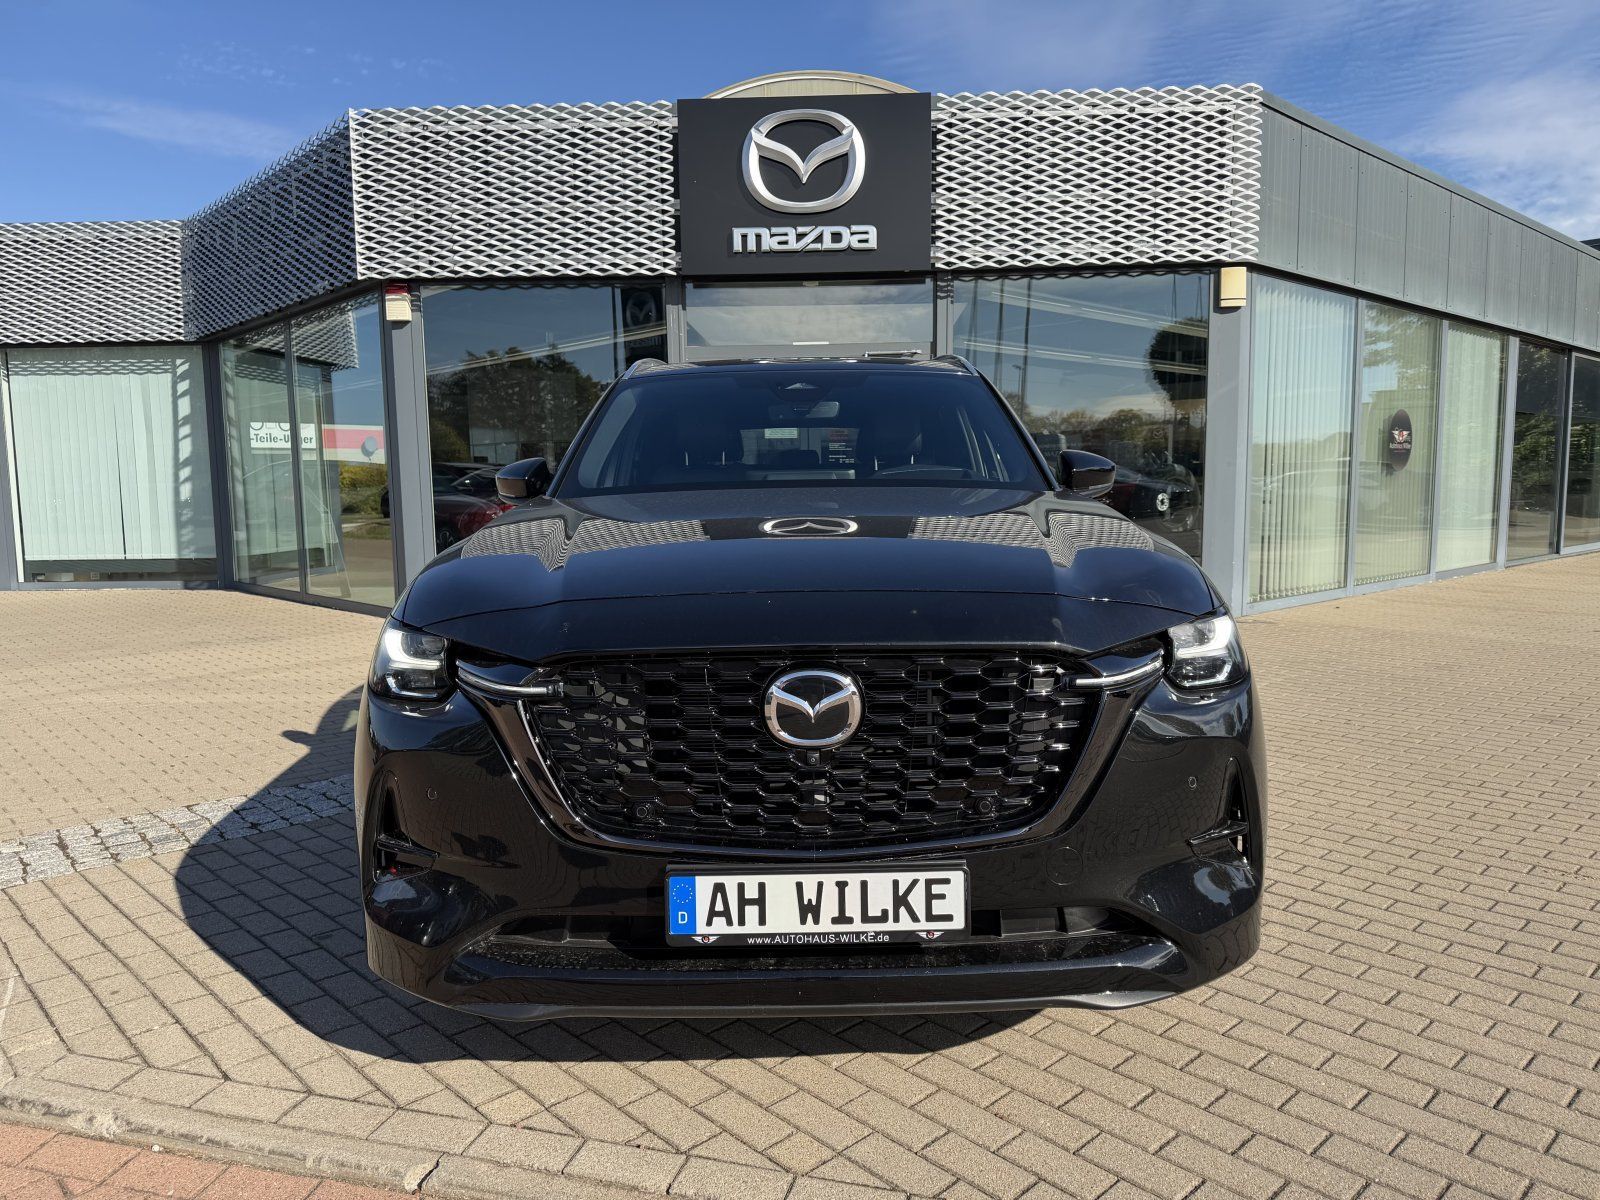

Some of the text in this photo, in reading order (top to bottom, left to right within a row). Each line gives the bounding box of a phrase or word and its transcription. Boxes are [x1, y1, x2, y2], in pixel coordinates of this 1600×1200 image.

[706, 878, 954, 927] AH WILKE
[678, 911, 688, 924] D
[747, 932, 890, 945] www.AUTOHAUS-WILKE.de
